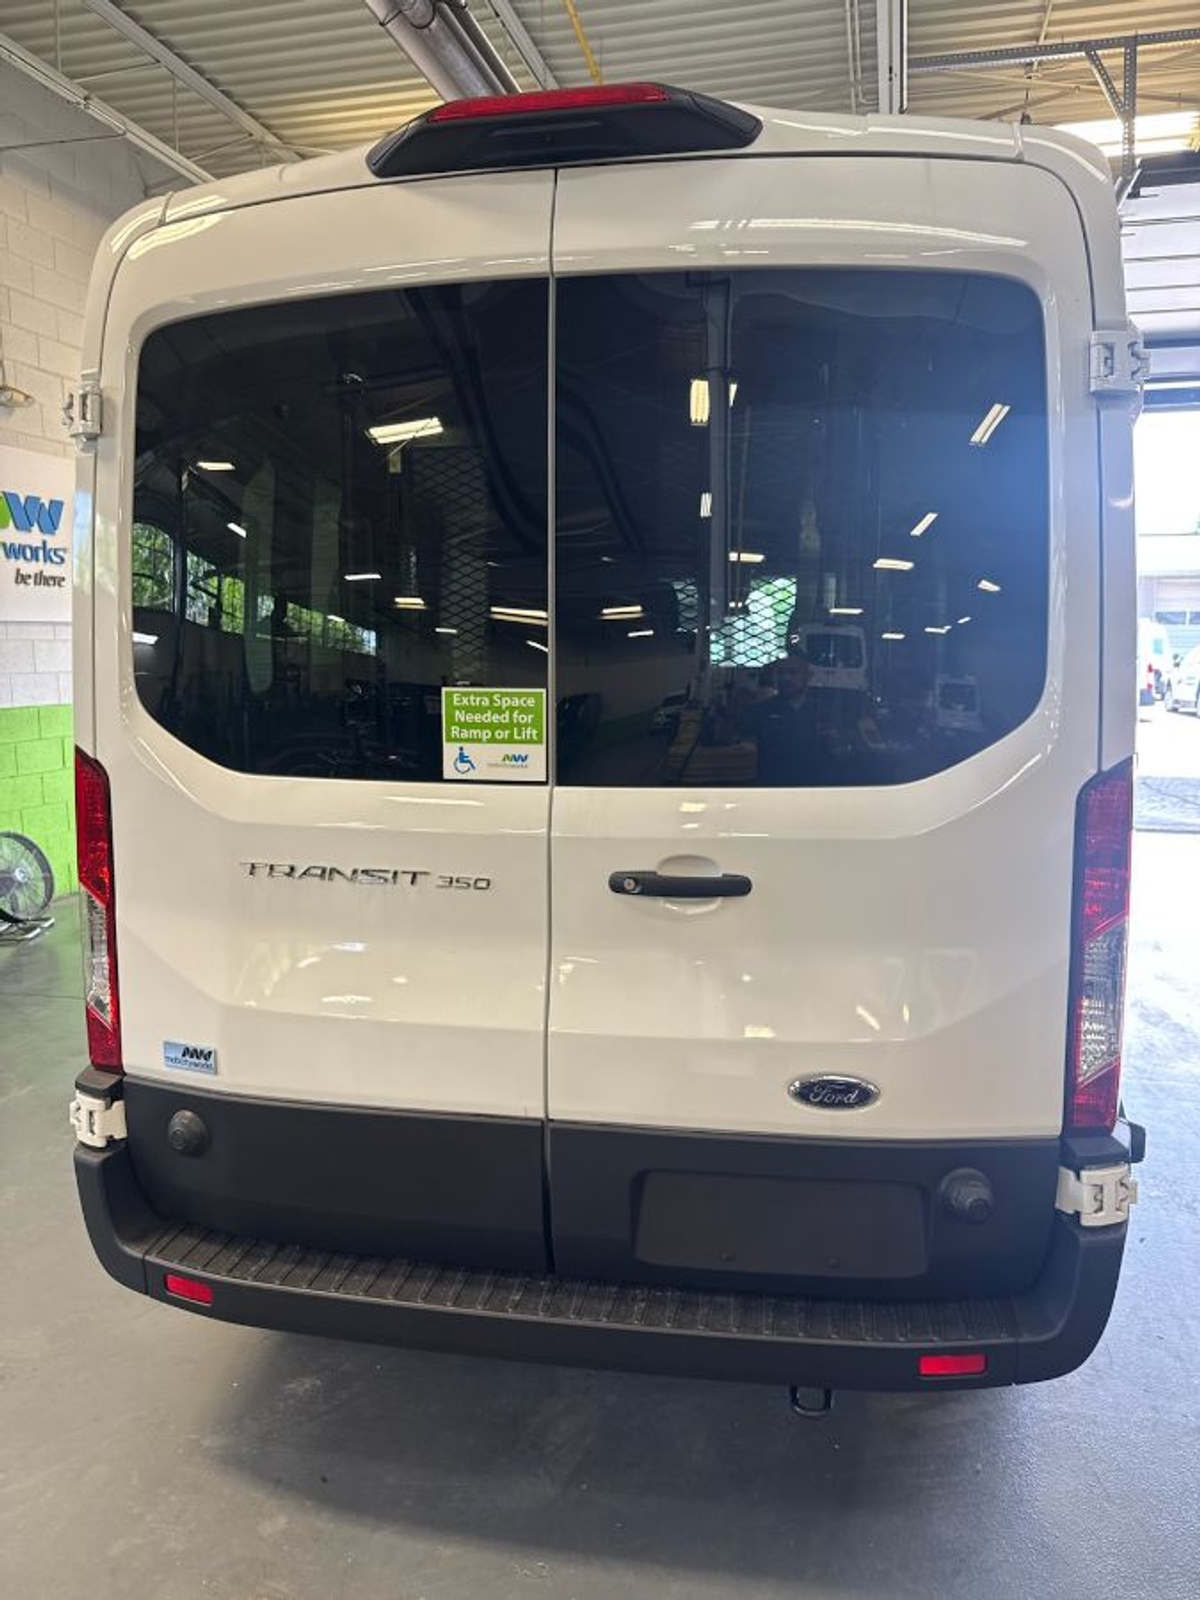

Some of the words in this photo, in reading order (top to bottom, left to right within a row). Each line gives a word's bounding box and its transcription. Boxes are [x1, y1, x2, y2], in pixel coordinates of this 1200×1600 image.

[15, 568, 31, 586] be
[34, 570, 65, 588] there
[453, 693, 490, 707] Extra
[492, 694, 536, 710] Space
[455, 710, 510, 723] Needed
[512, 711, 534, 723] for
[451, 726, 492, 742] Ramp
[494, 730, 510, 740] or
[513, 727, 538, 740] Lift
[240, 862, 431, 886] TRANSIT
[436, 875, 491, 890] 350
[809, 1083, 859, 1104] Ford
